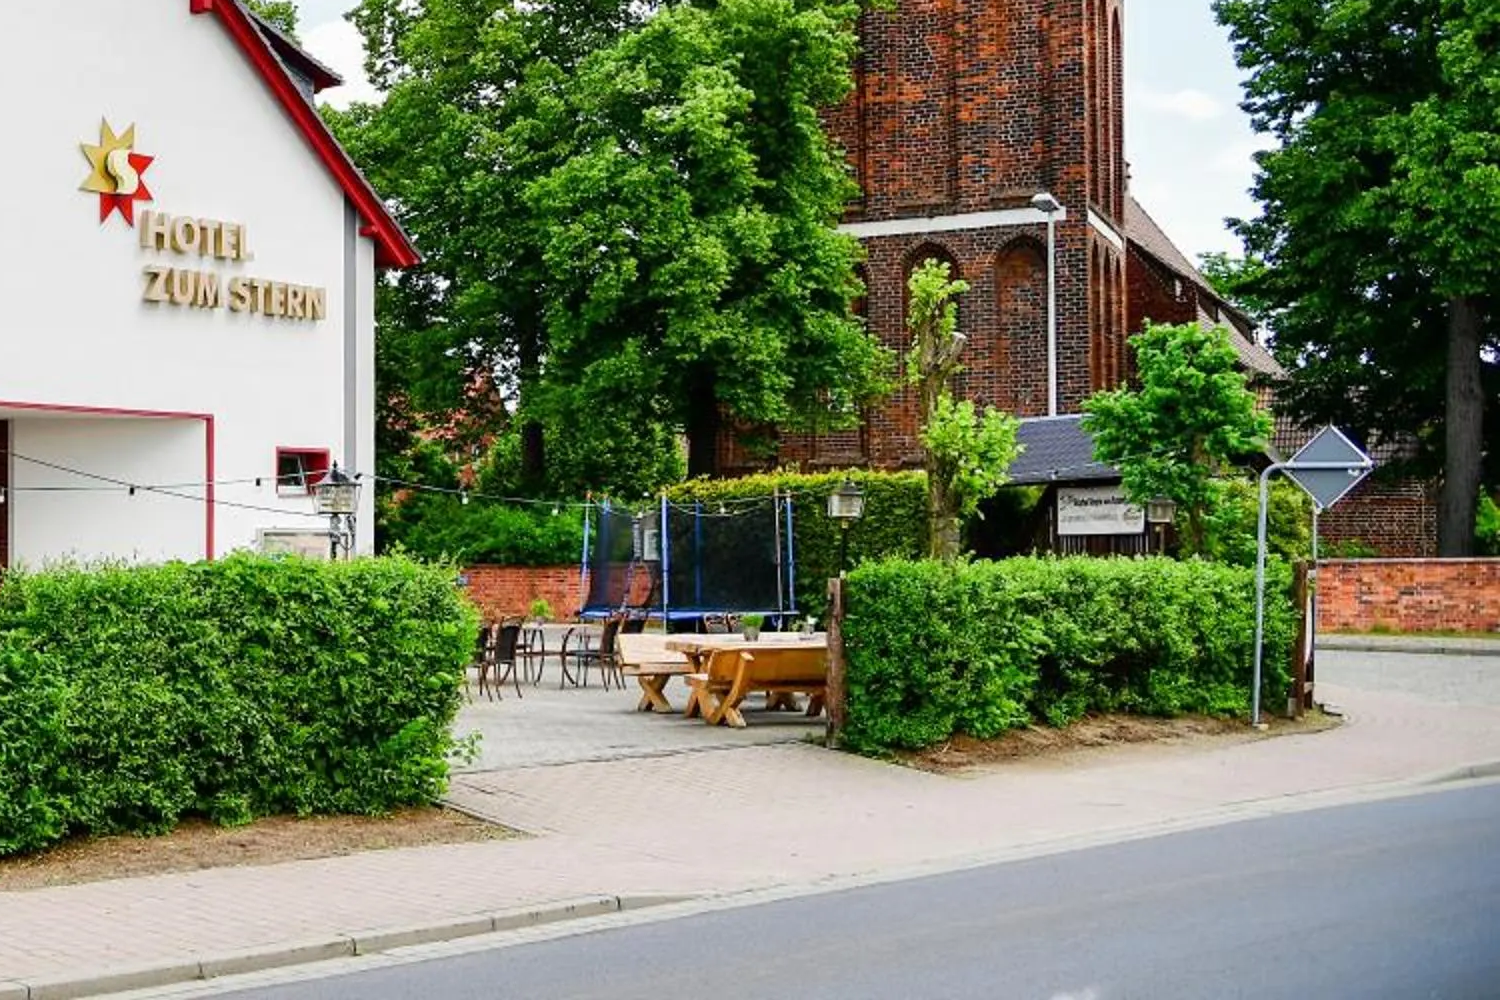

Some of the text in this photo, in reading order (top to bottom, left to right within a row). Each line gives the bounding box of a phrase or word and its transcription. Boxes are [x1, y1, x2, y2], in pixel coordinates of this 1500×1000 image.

[140, 210, 252, 262] HOTEL
[143, 265, 327, 320] ZUM STERN
